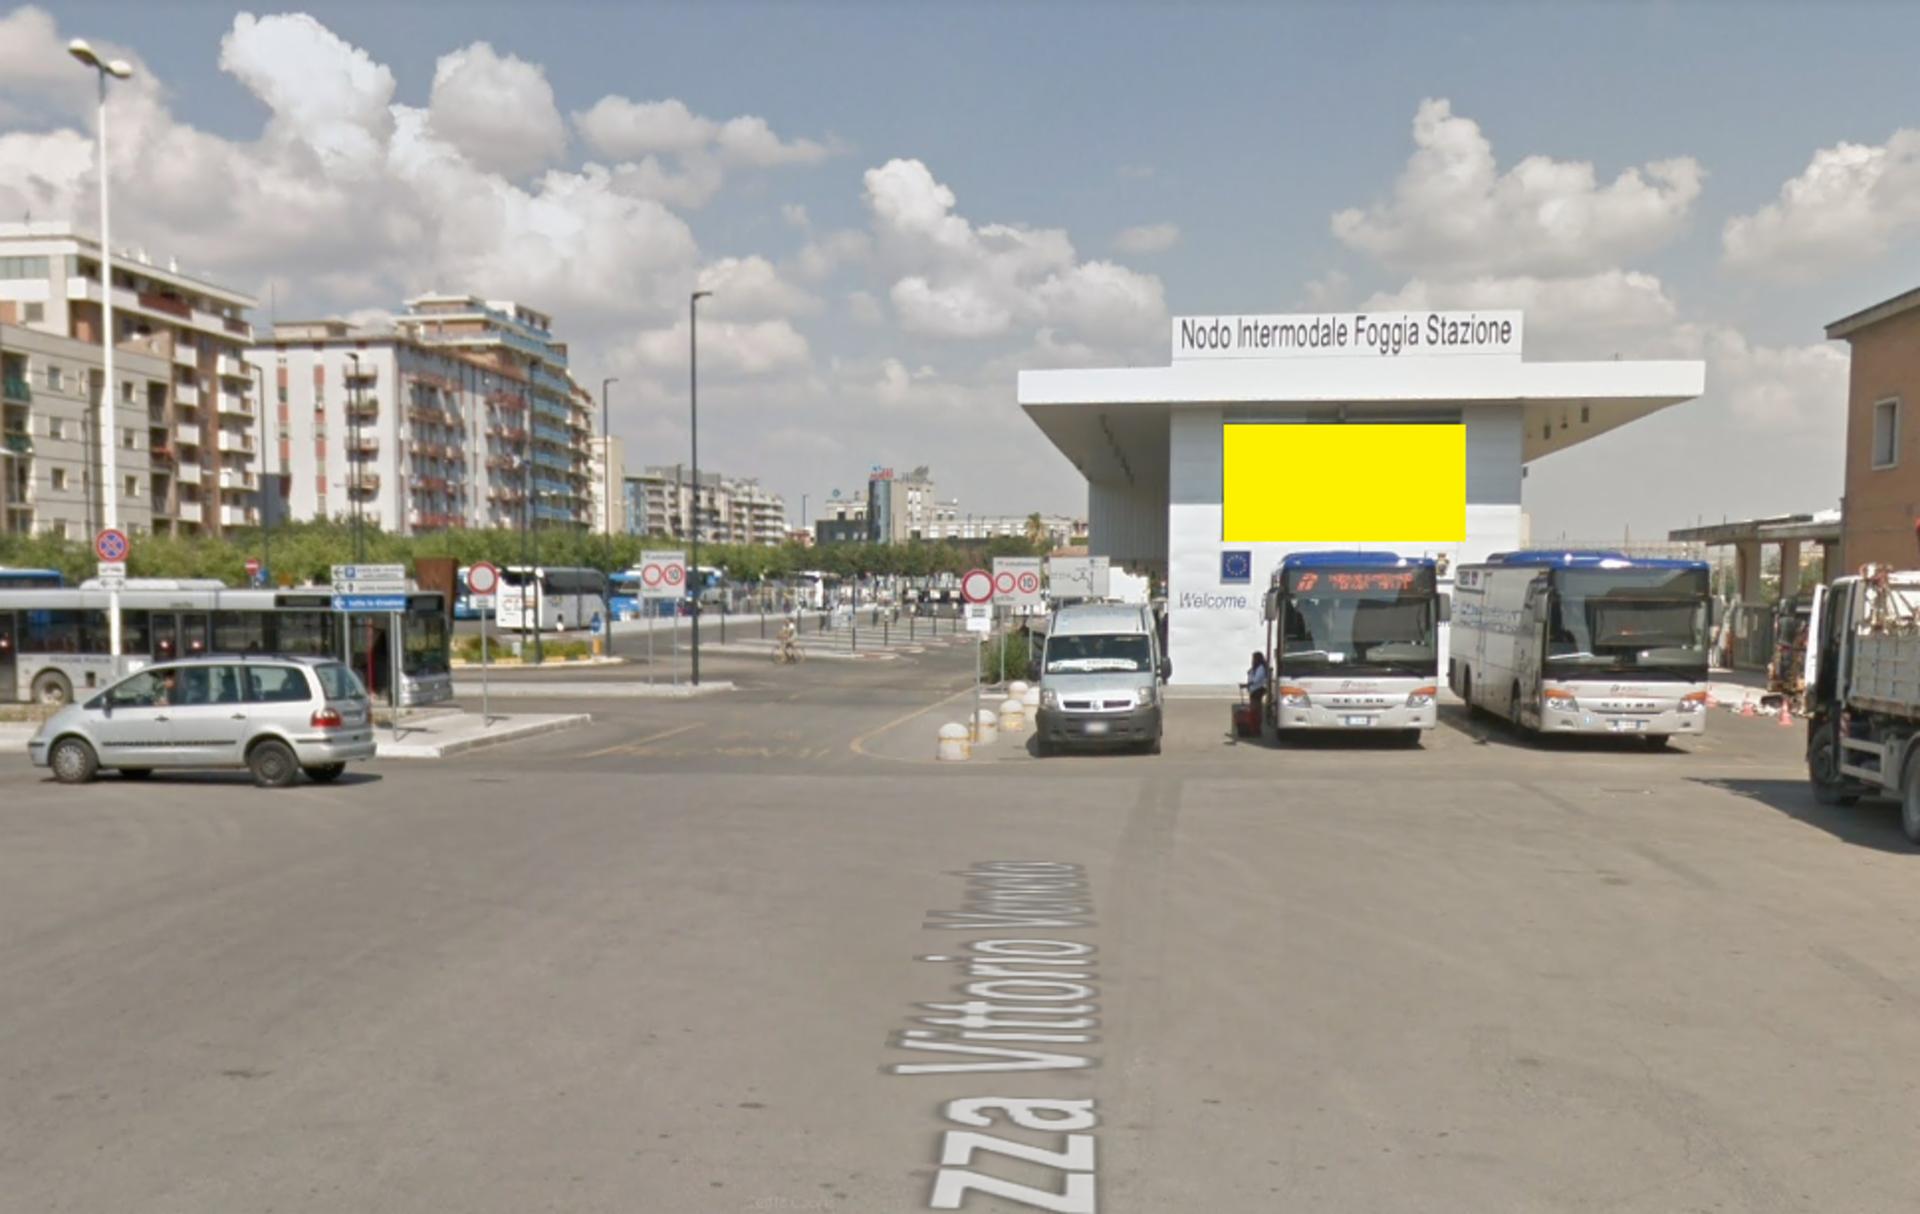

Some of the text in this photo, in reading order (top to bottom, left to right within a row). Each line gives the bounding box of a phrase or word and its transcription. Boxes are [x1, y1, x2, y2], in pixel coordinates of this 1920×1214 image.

[1181, 313, 1513, 355] Nodo Intermodale Foggia Stazione
[1179, 592, 1248, 609] Welcome
